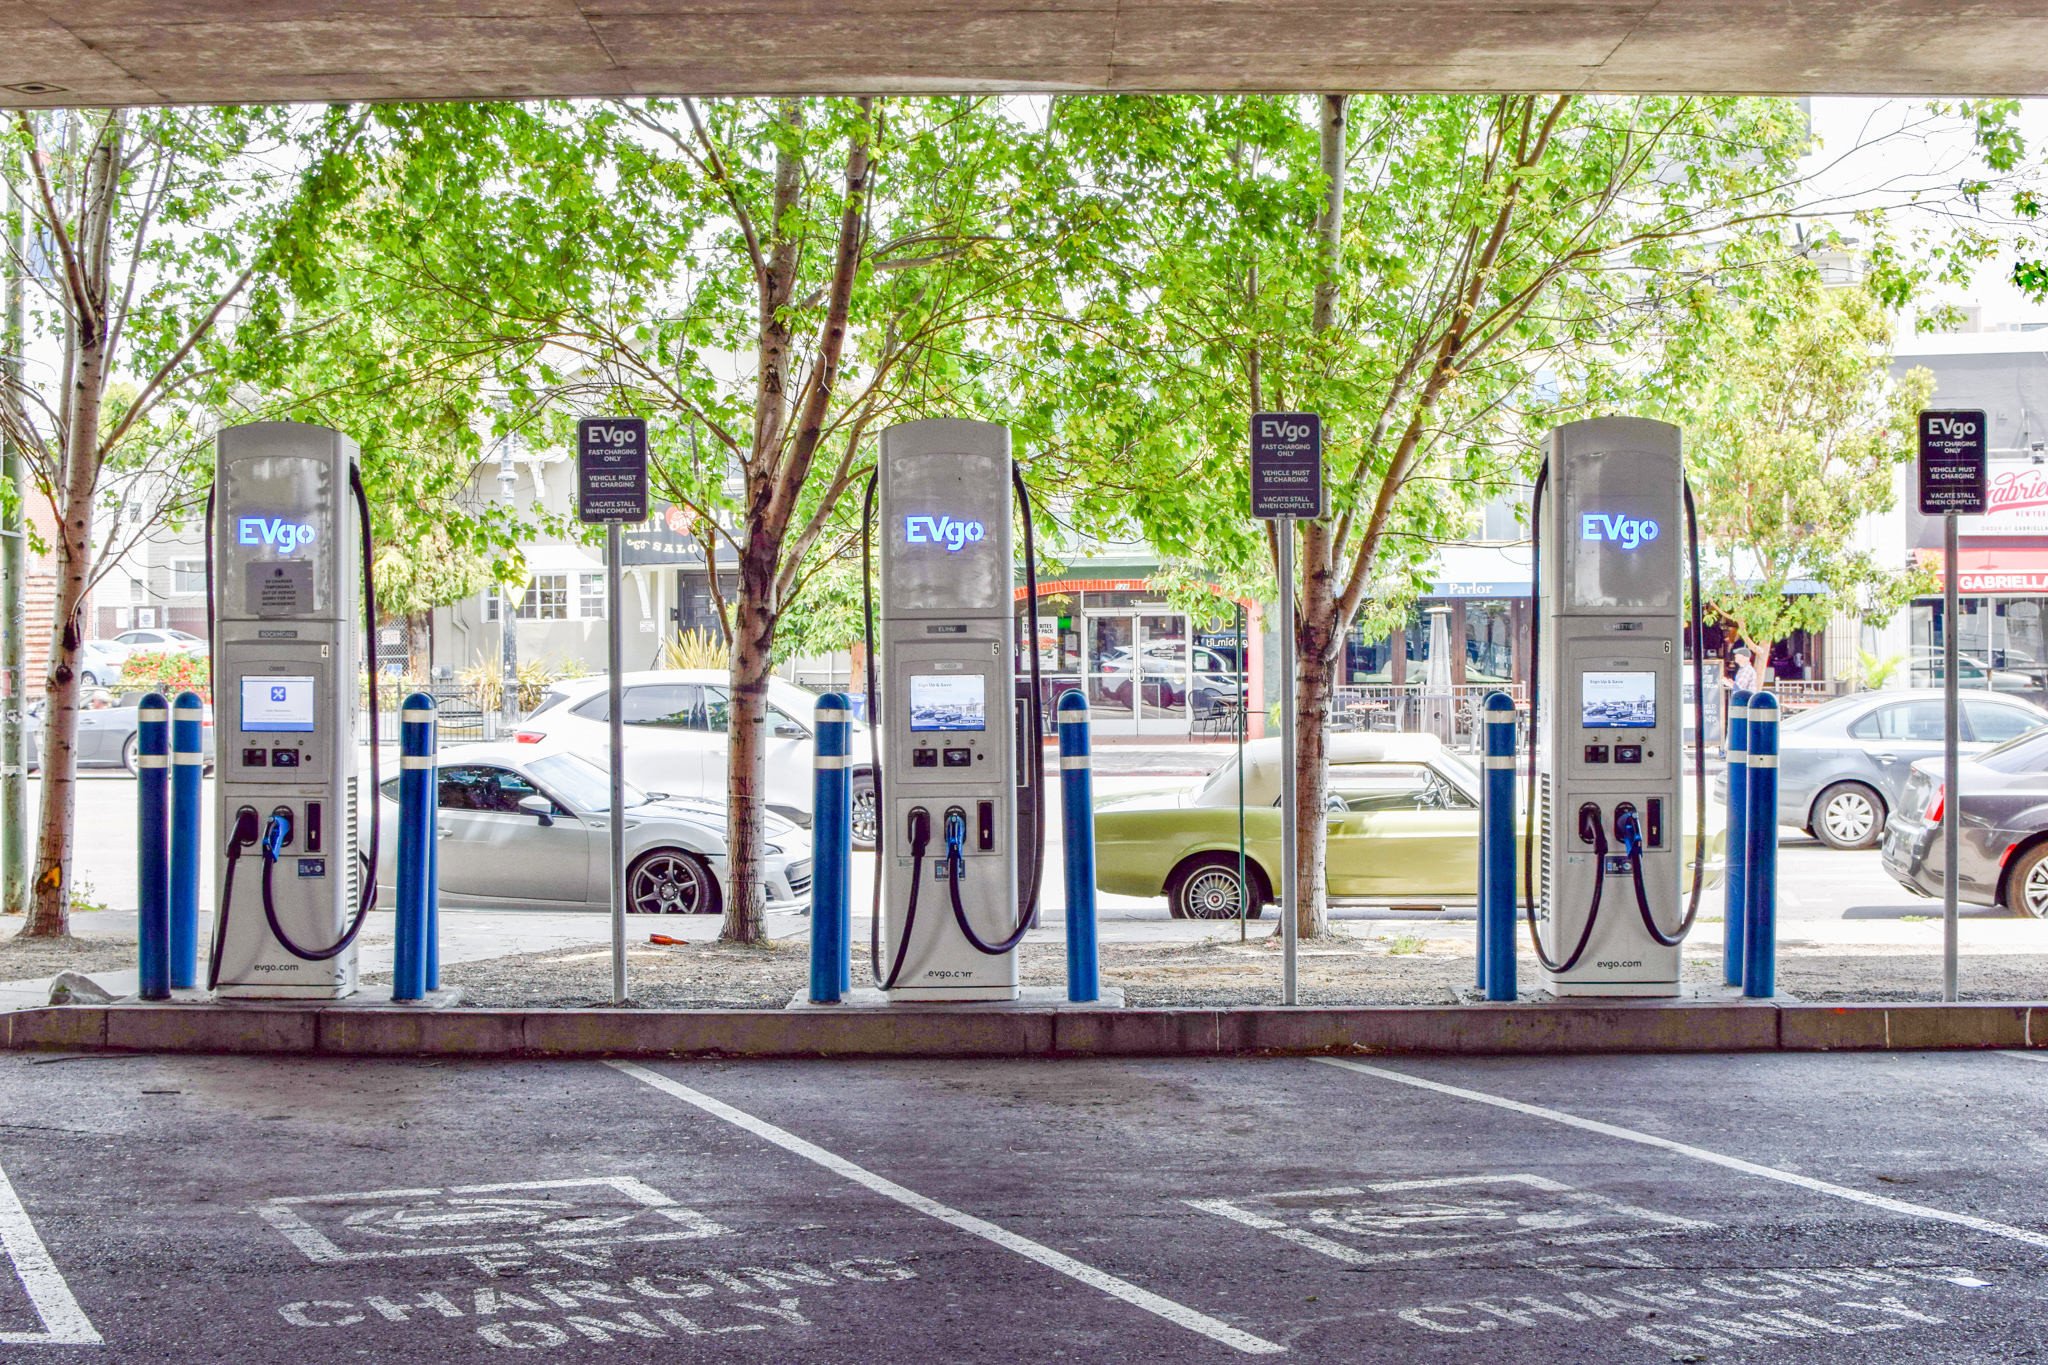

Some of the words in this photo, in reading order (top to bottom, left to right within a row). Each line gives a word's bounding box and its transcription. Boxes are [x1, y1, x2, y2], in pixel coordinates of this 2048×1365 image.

[588, 426, 637, 447] EVgo
[1261, 421, 1310, 442] EVgo
[1928, 418, 1976, 439] EVgo
[1985, 469, 2048, 504] abrie
[239, 518, 316, 553] EVgo
[906, 516, 984, 550] EVgo
[1582, 514, 1659, 549] EVgo
[652, 539, 724, 554] SALON
[1449, 582, 1493, 594] Parlor
[383, 634, 398, 642] EXIT
[1664, 642, 1669, 652] 6
[322, 646, 327, 656] 4
[994, 644, 999, 654] 5
[254, 963, 299, 973] evgo.com
[1597, 960, 1642, 969] evgo.com
[277, 1258, 918, 1328] CHARGING
[476, 1298, 812, 1349] ONLY
[1626, 1296, 1948, 1350] ONLY
